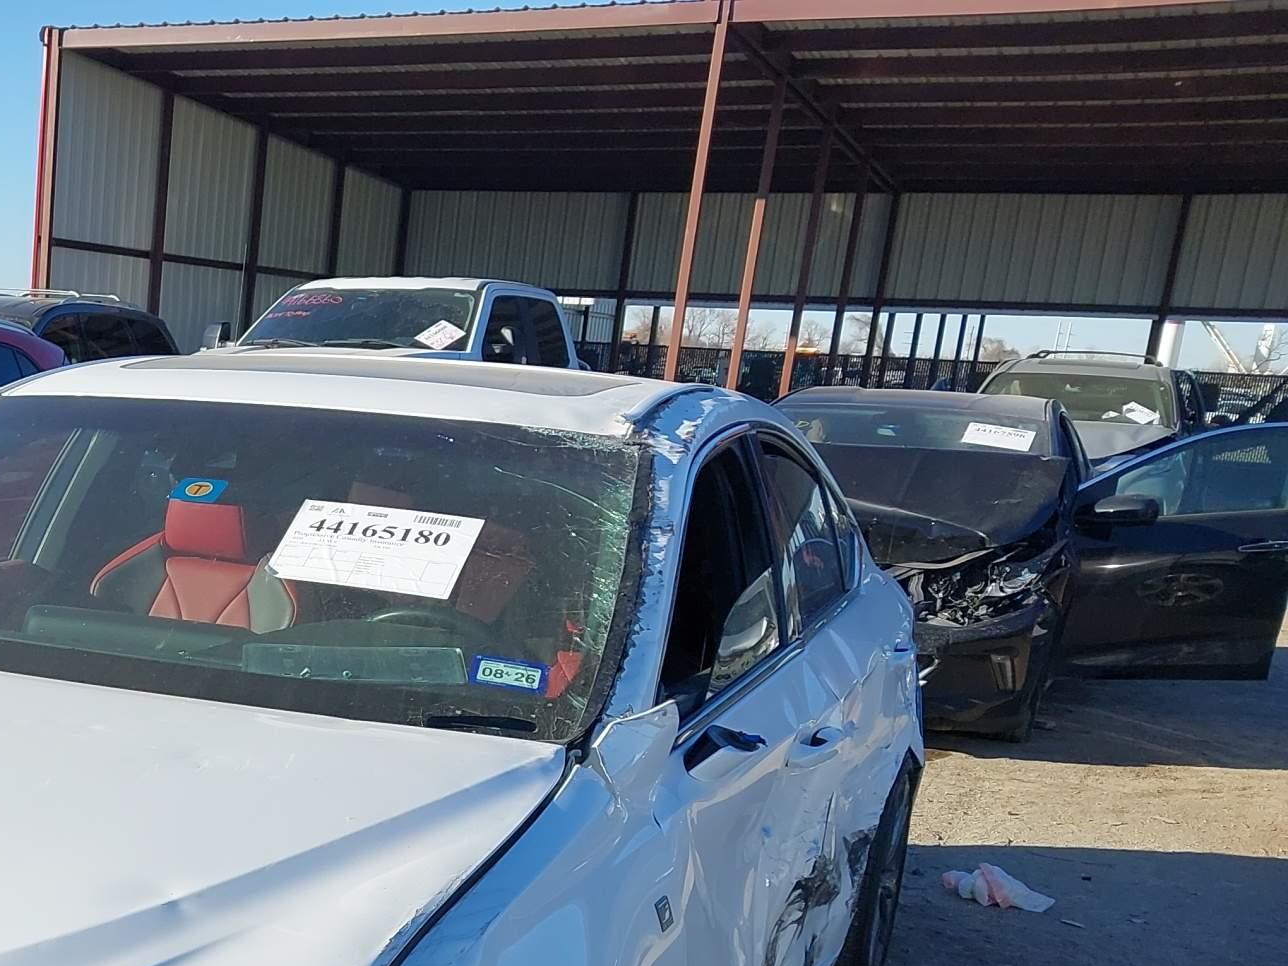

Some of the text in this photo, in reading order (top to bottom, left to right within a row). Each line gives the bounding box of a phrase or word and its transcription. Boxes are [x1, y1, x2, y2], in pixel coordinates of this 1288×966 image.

[309, 517, 451, 547] 44165180
[481, 666, 505, 679] 08
[514, 671, 537, 685] 26
